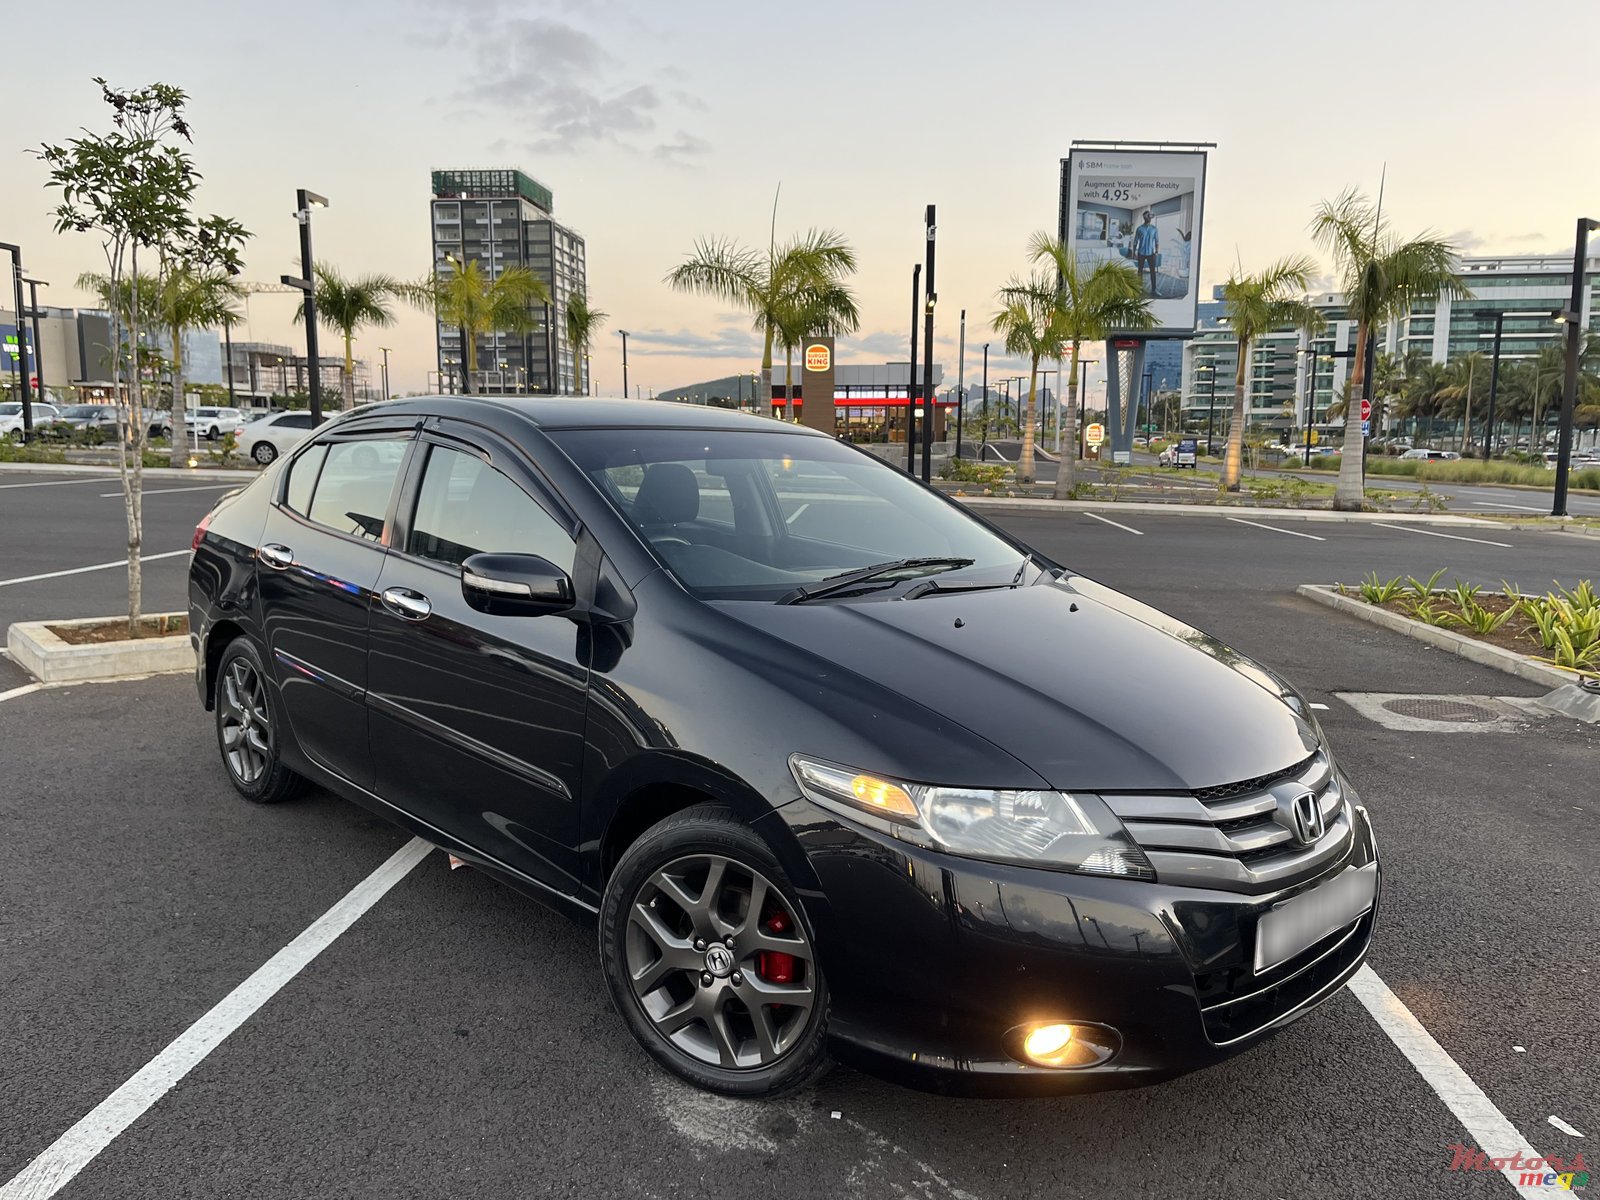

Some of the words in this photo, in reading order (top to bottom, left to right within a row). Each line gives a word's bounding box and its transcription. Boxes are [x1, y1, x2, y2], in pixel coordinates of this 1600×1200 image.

[1086, 161, 1102, 169] SBM
[1085, 181, 1115, 189] Augment
[1156, 182, 1180, 190] Reality
